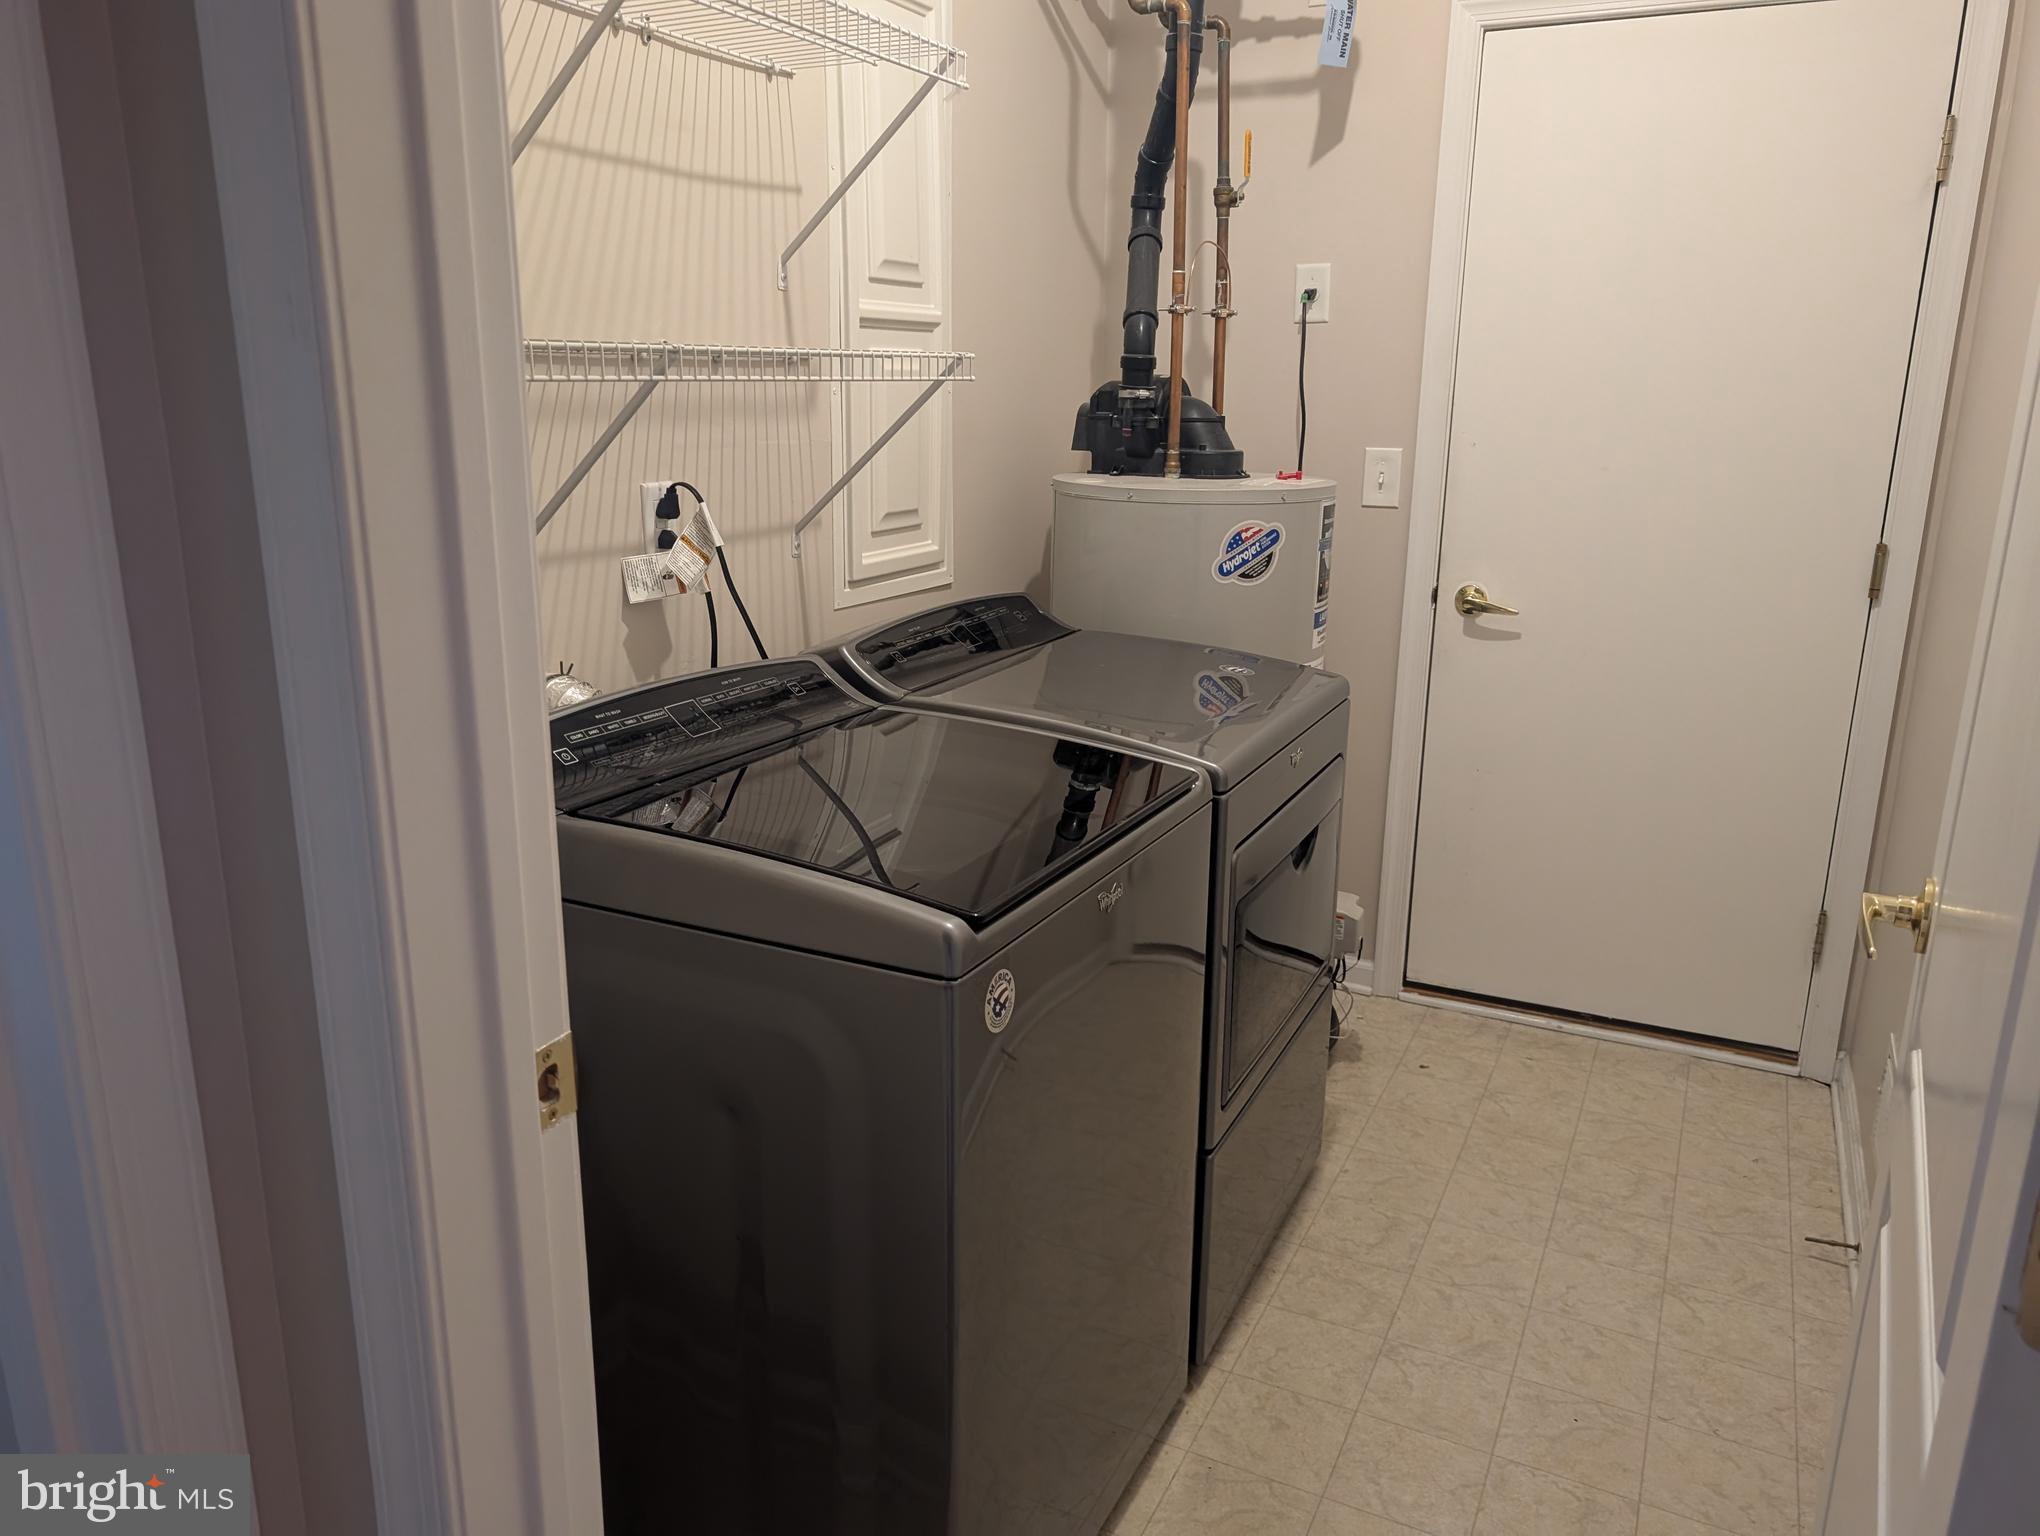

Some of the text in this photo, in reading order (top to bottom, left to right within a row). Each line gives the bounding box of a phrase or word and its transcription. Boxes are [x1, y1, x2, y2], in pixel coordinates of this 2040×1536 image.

[1339, 32, 1350, 58] MAIN
[1222, 542, 1260, 573] Hydrojet
[987, 971, 1012, 1005] AMERICA
